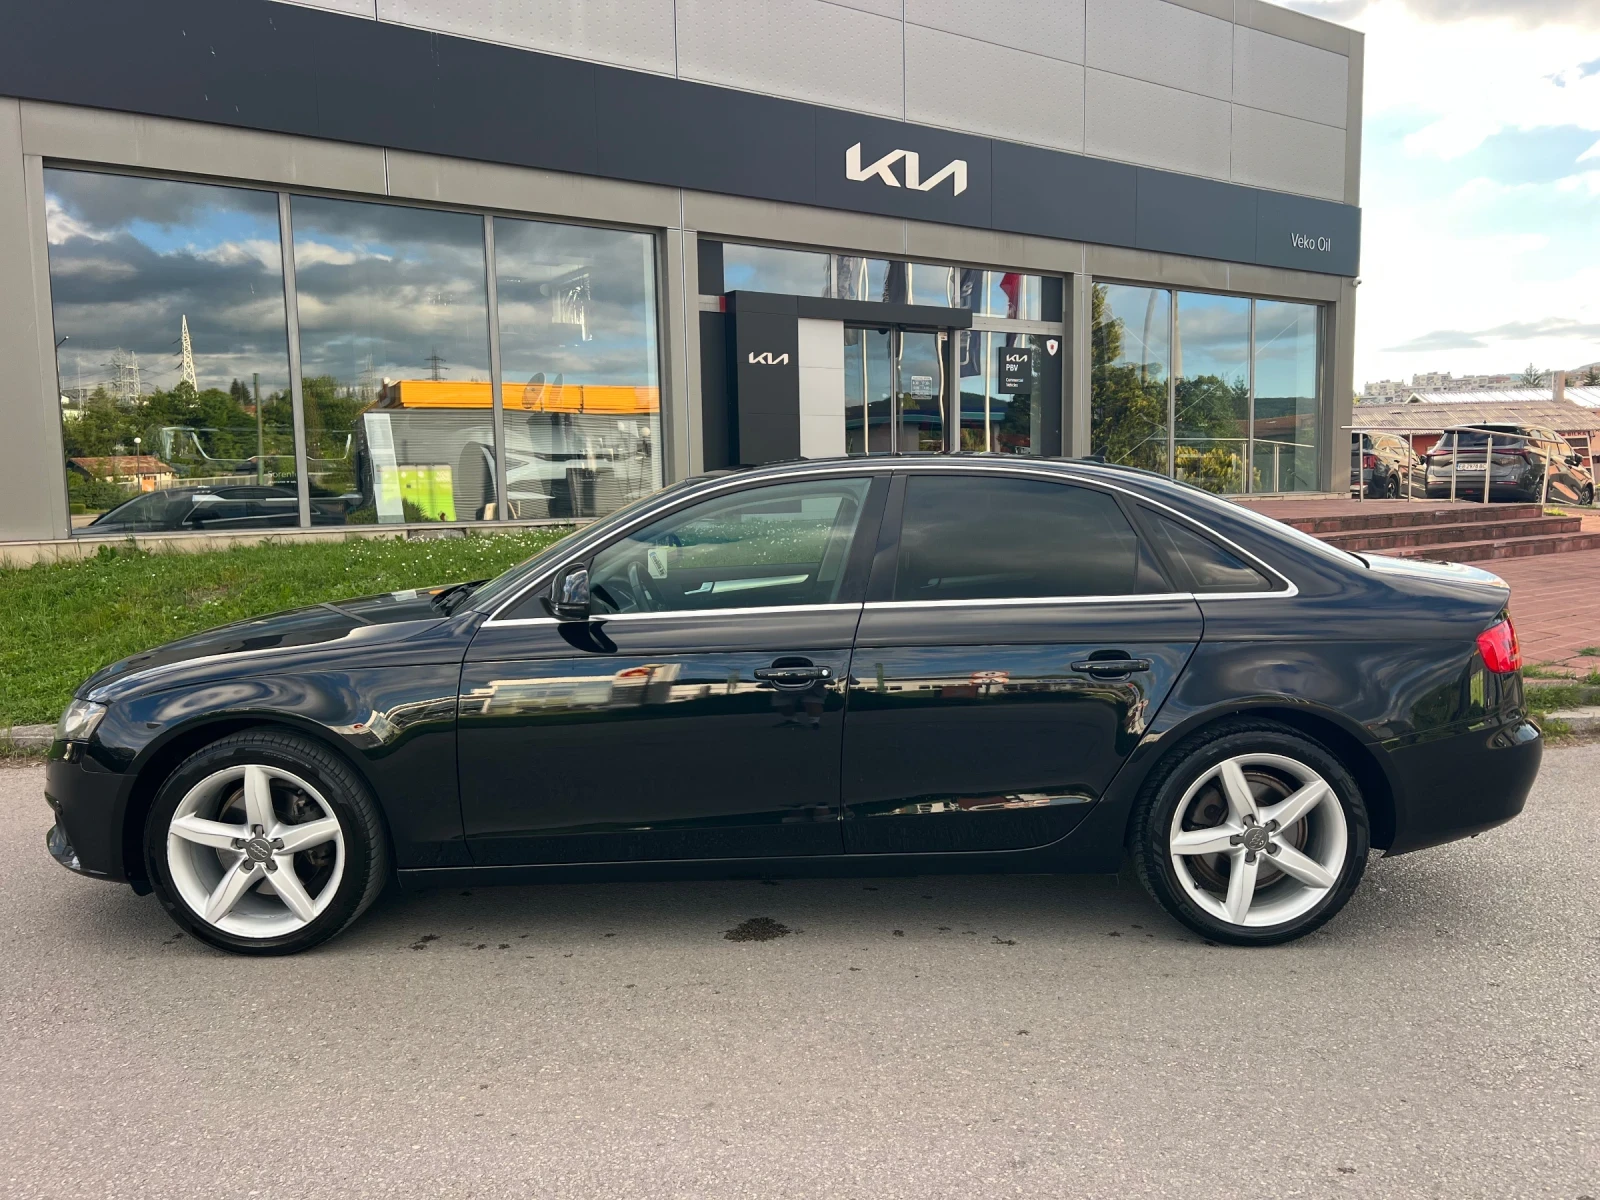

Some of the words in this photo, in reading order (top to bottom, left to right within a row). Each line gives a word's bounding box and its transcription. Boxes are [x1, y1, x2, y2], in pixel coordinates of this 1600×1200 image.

[845, 141, 968, 197] KIA
[1291, 232, 1316, 250] Veko
[1317, 236, 1331, 252] Oil
[748, 351, 789, 366] KIA
[1006, 354, 1028, 363] KIA
[1005, 363, 1019, 372] PBV
